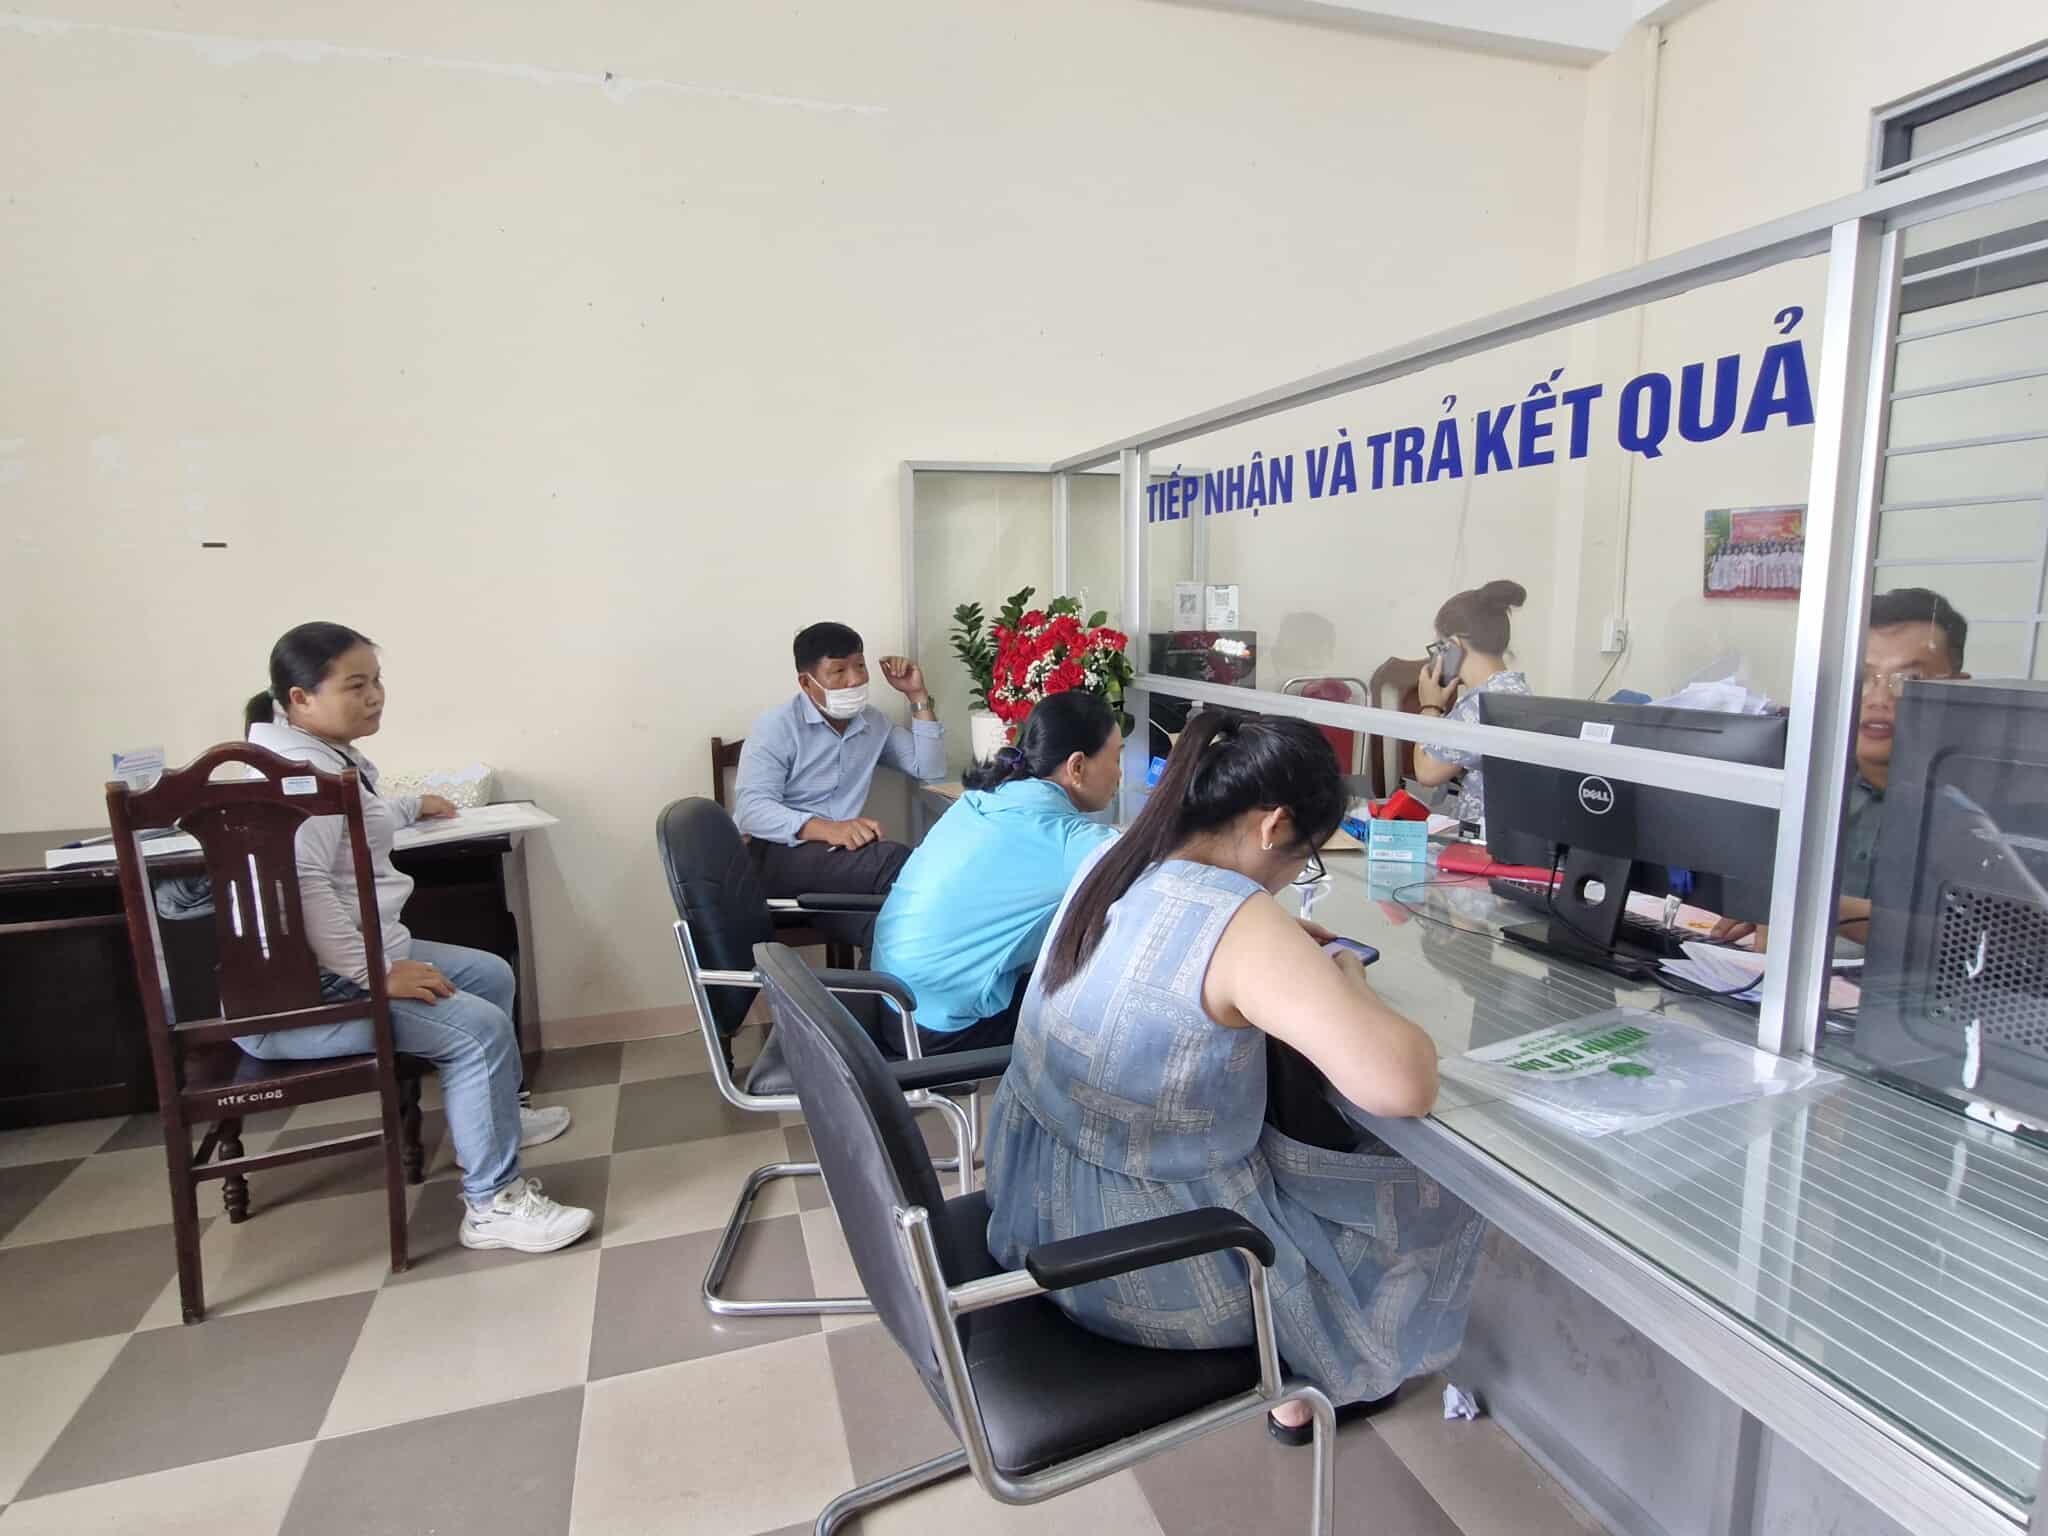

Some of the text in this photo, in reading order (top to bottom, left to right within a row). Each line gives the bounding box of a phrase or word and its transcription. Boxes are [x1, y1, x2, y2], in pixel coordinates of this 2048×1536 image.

[1146, 305, 1816, 523] TIẾP NHẬN VÀ TRẢ KẾT QUẢ
[1582, 788, 1609, 801] DELL
